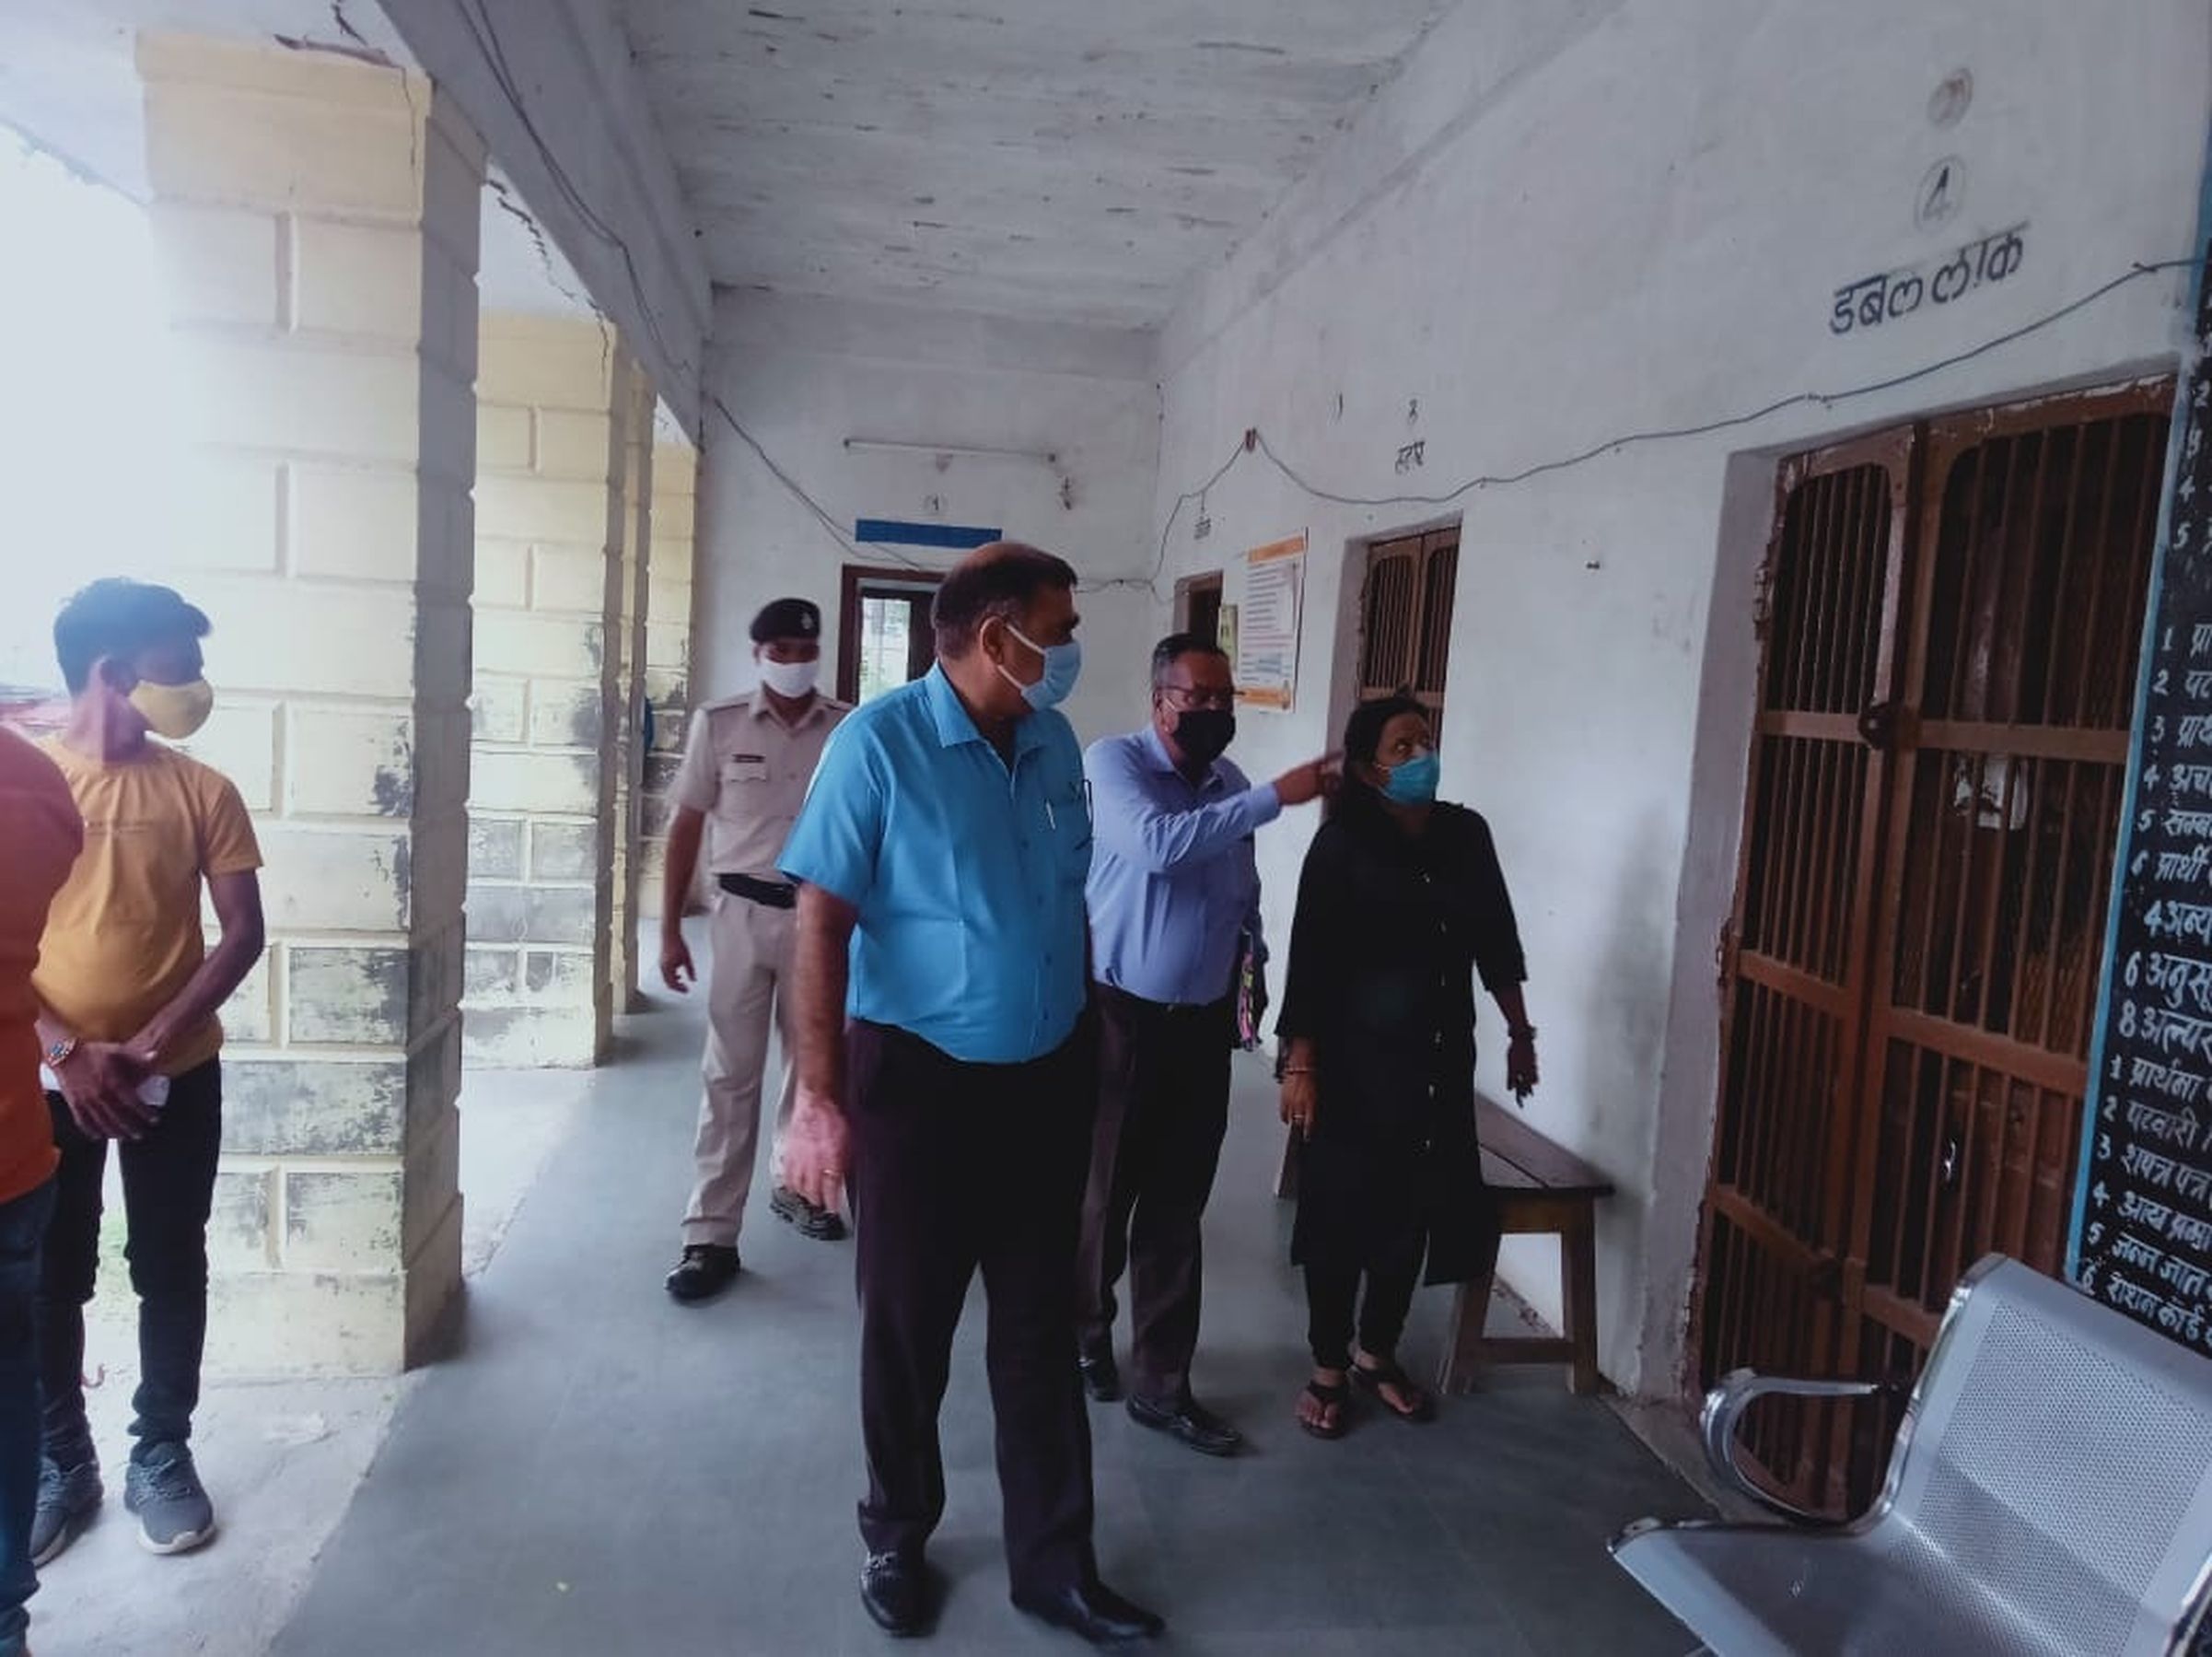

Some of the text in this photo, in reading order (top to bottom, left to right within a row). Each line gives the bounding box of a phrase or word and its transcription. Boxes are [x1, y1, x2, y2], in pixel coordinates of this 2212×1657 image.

[2151, 668, 2171, 696] 2
[2143, 764, 2161, 792] 4
[2143, 899, 2163, 939] 4
[2124, 951, 2142, 988] 6
[2118, 998, 2137, 1039] 8
[2096, 1132, 2112, 1161] 3
